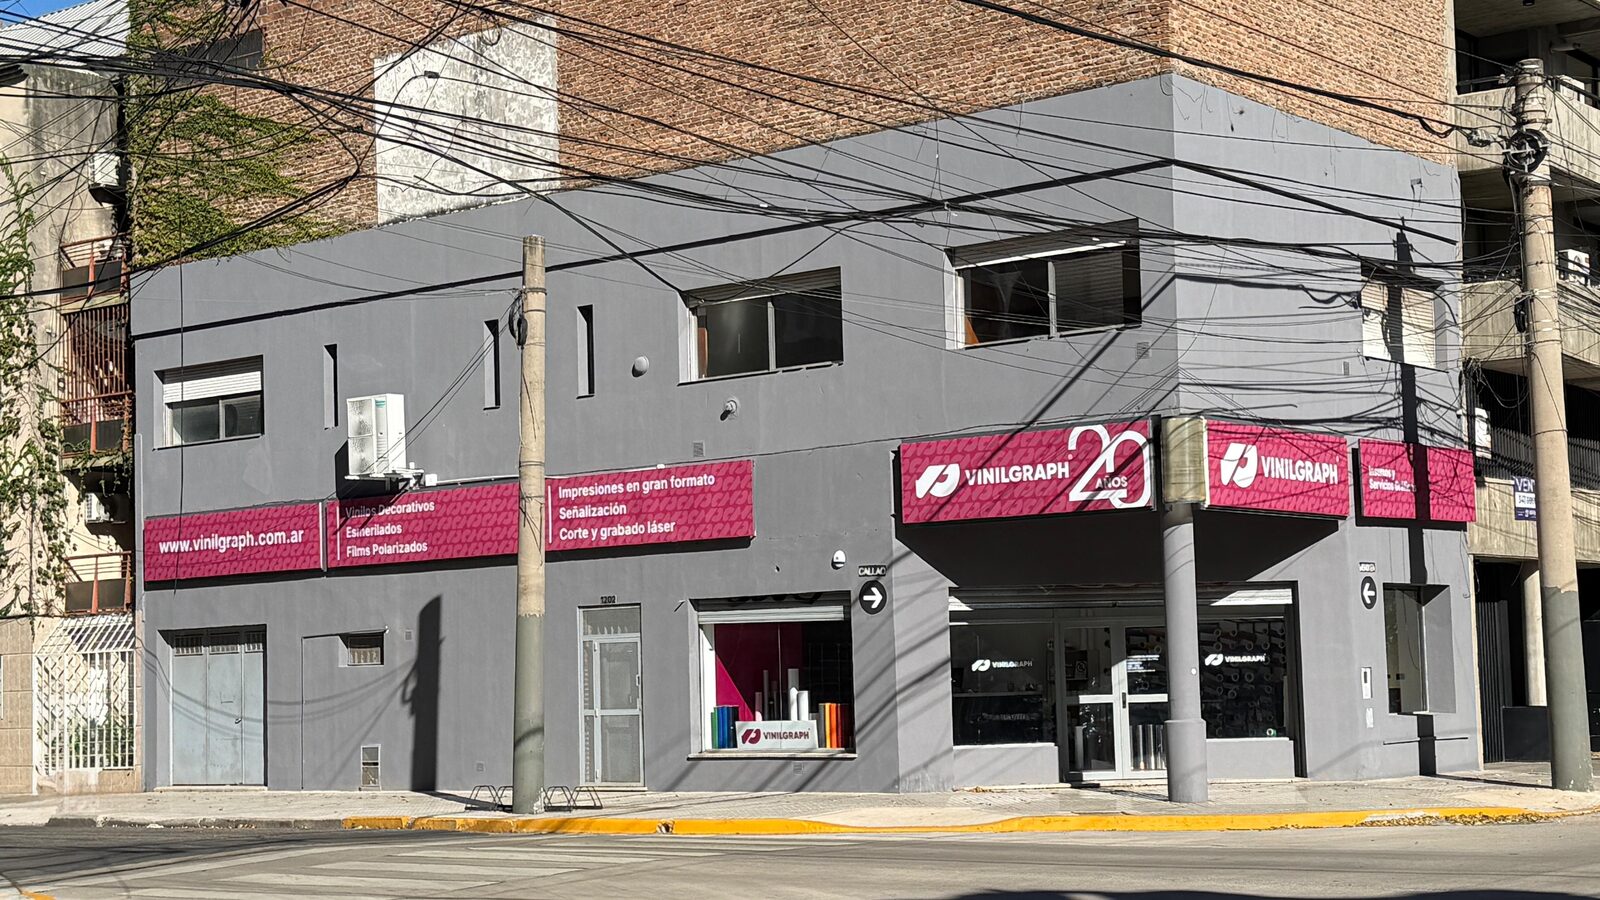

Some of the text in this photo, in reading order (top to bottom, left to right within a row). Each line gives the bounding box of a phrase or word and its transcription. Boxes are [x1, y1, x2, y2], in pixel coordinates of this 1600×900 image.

[964, 461, 1070, 486] VINILGRAPH
[1068, 424, 1151, 509] 20
[1260, 456, 1338, 485] VINILGRAPH
[558, 473, 716, 500] Impresiones en gran formato
[1095, 474, 1128, 489] AÑOS
[378, 500, 435, 516] Decorativos
[559, 502, 627, 519] Señalización
[346, 523, 403, 539] Esmerilados
[559, 520, 676, 540] Corte y grabado láser
[158, 529, 304, 554] www.vinilgraph.com.ar
[346, 541, 428, 558] Films Polarizados
[858, 566, 886, 576] CALLAO
[600, 595, 616, 604] 1202
[763, 731, 810, 740] VINILGRAPH
